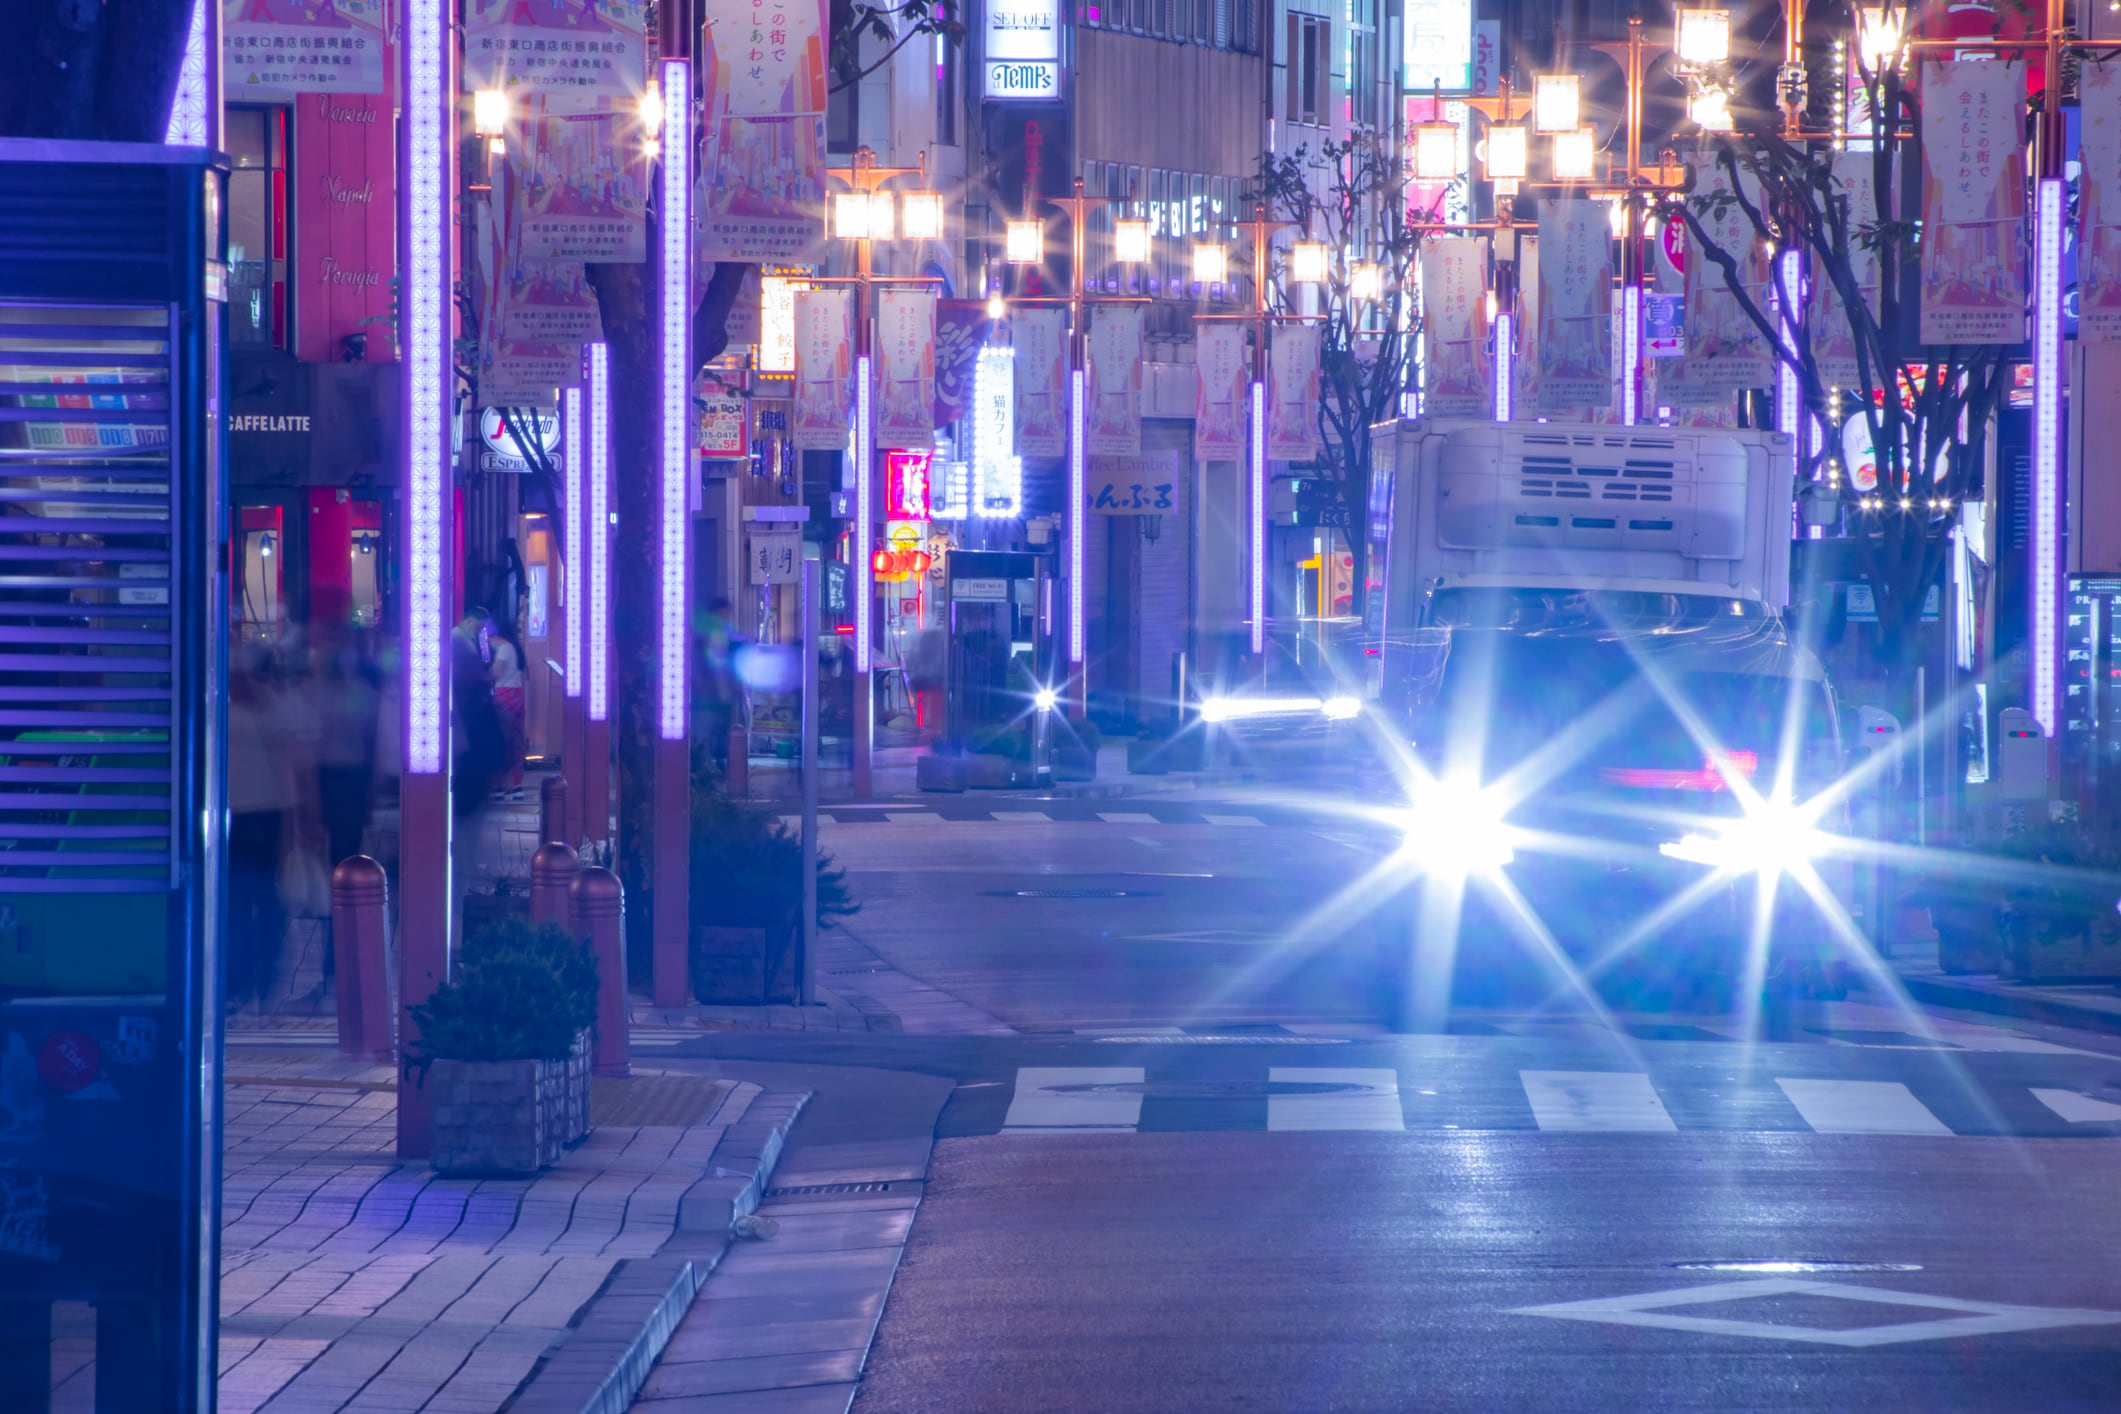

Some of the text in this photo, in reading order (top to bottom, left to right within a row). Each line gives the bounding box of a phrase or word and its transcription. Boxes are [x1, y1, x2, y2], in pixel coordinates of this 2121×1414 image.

[320, 95, 377, 123] Venezia
[1958, 91, 1972, 193] 会えるしあわせ
[1976, 91, 1991, 178] またこの街で
[322, 175, 375, 208] Napoli
[321, 257, 379, 296] Perugia
